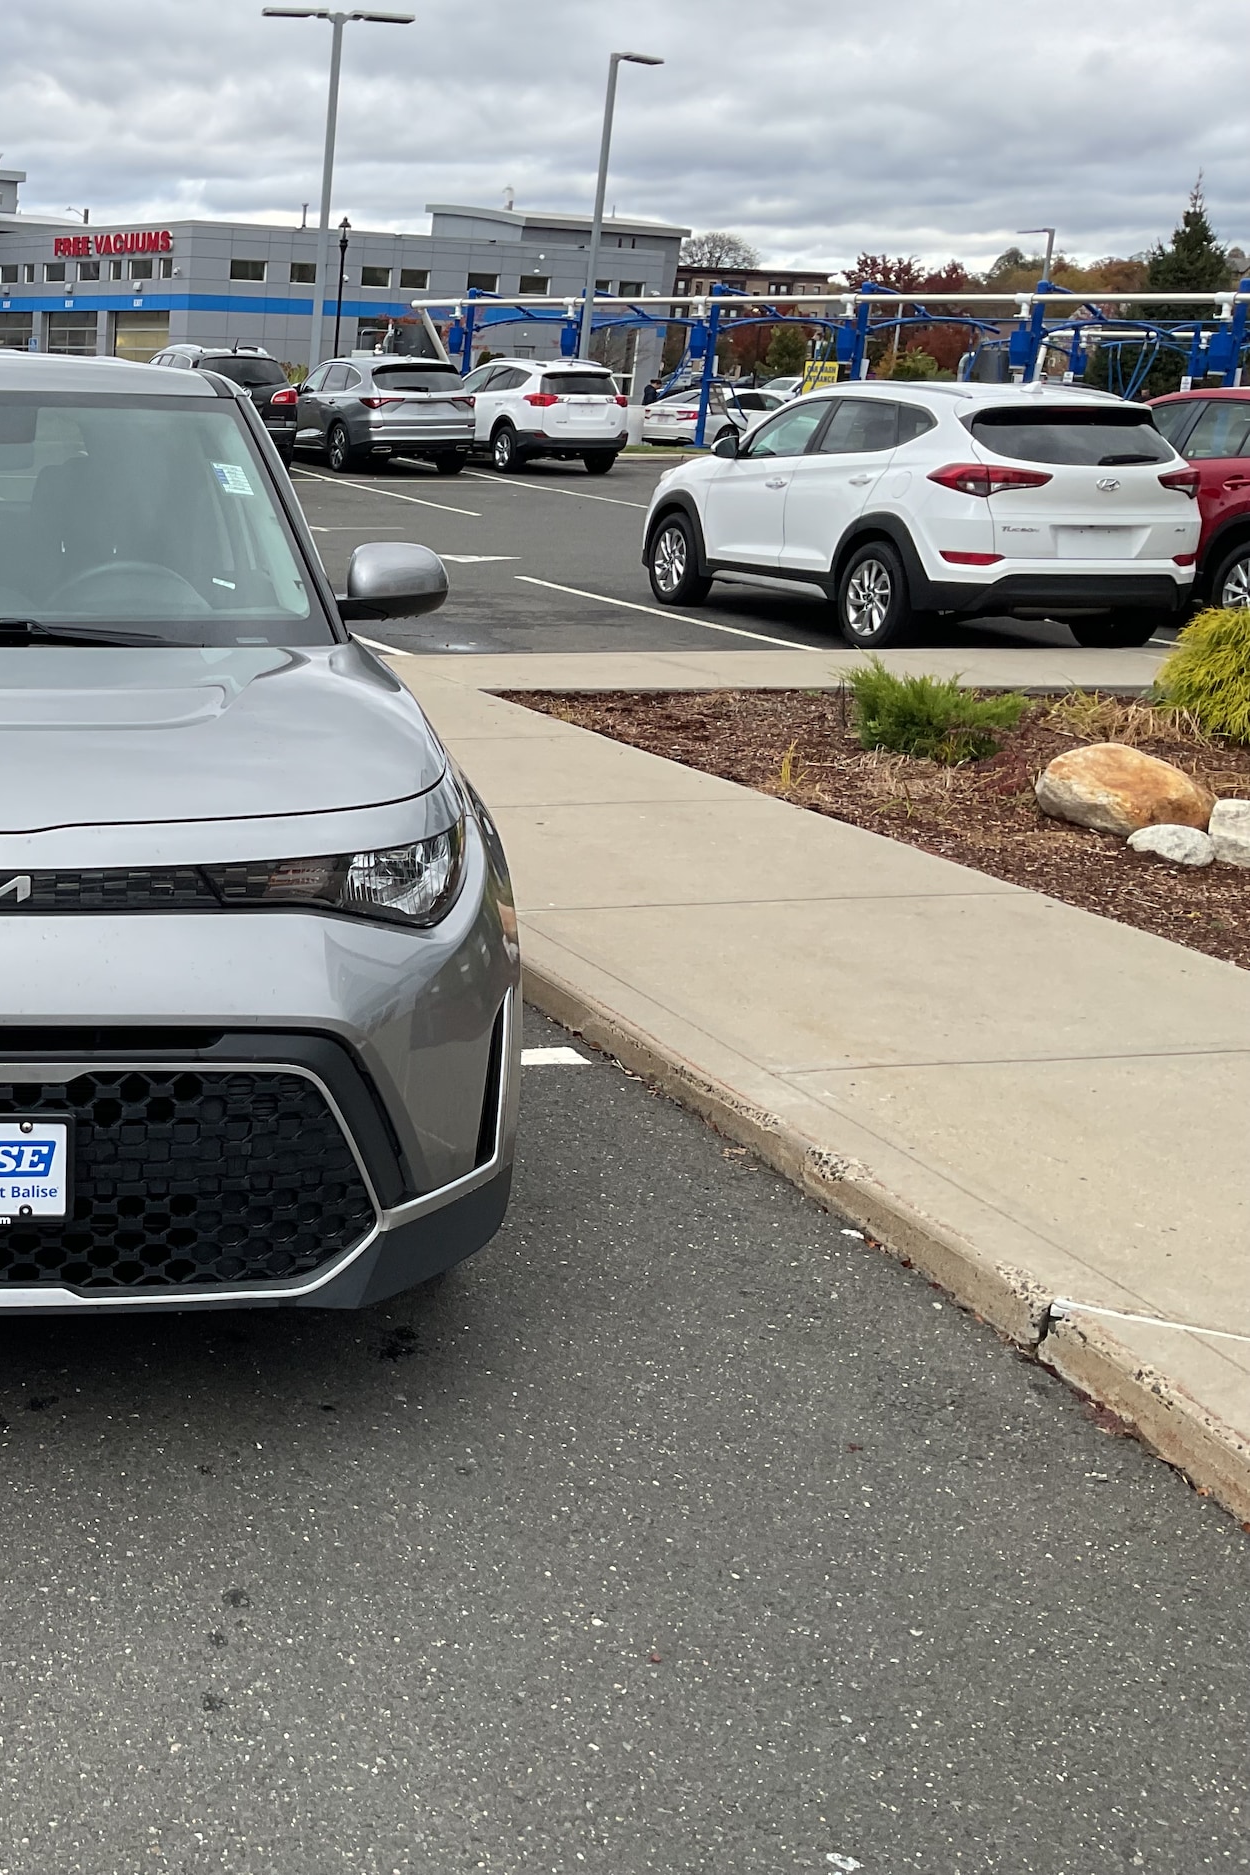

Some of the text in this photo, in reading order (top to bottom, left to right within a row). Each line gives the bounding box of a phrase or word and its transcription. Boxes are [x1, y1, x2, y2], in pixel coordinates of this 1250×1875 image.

[54, 230, 173, 257] FREE VACUUMS
[11, 1185, 58, 1198] Balise
